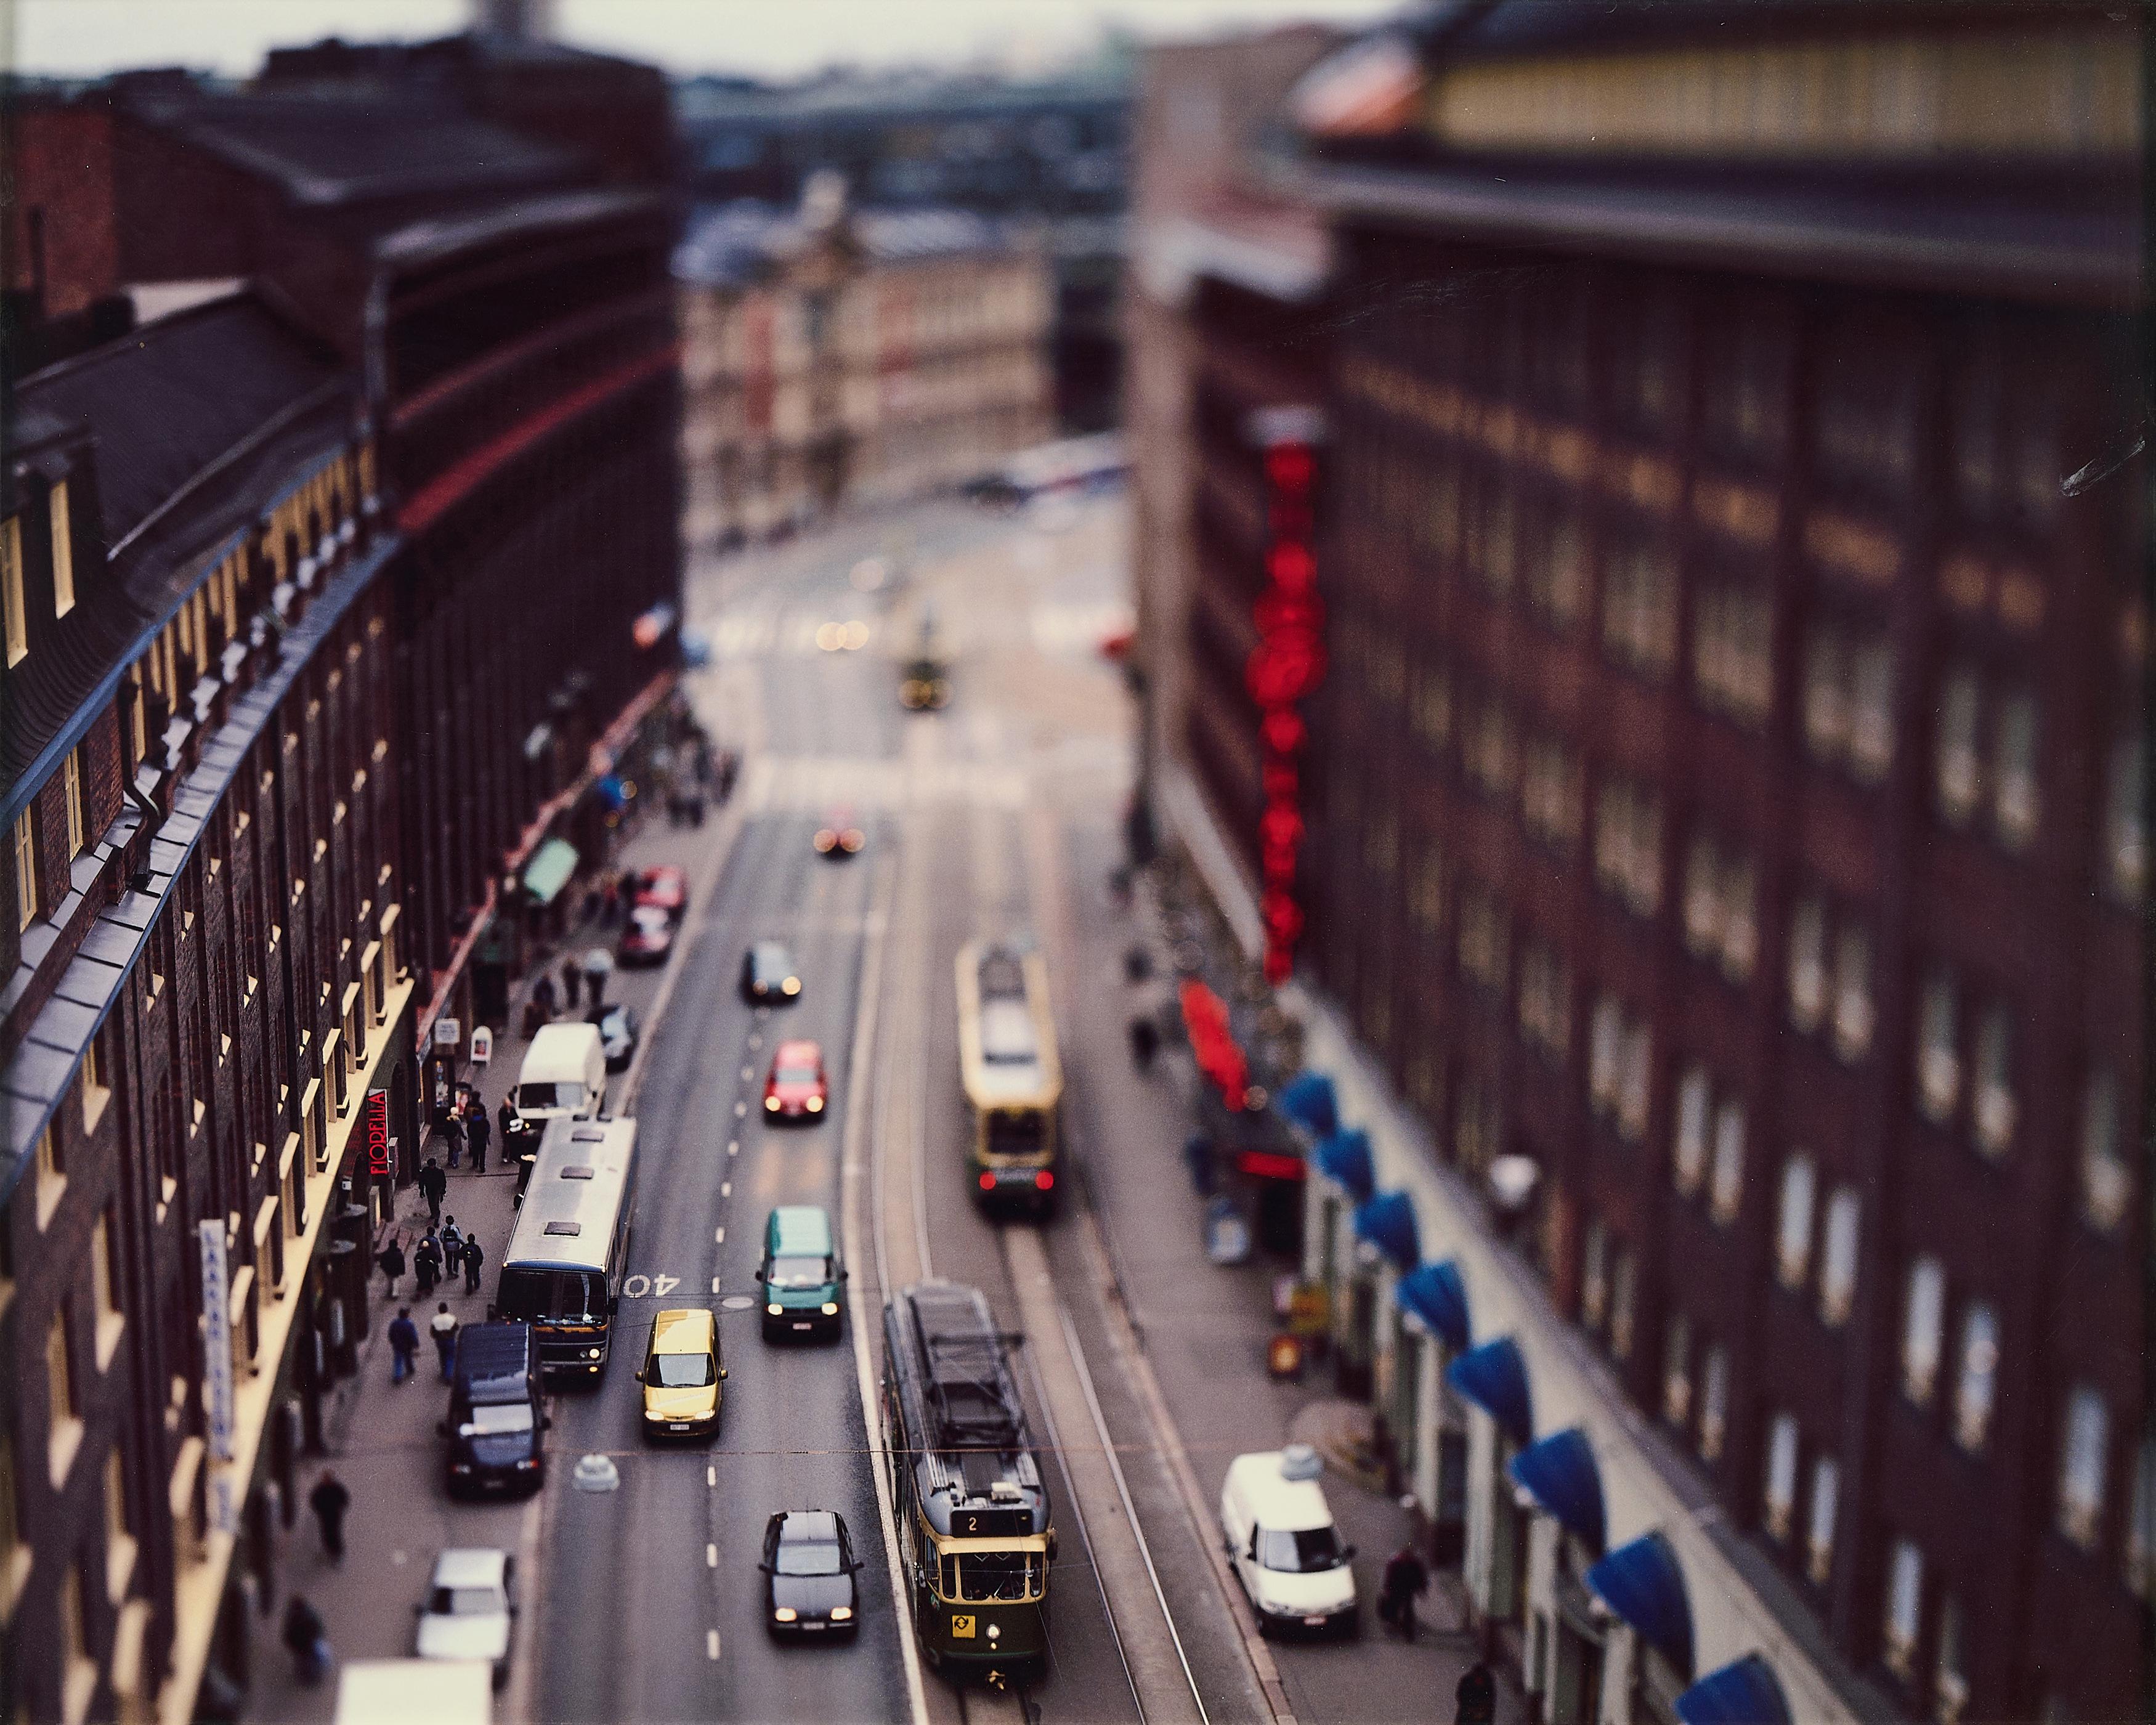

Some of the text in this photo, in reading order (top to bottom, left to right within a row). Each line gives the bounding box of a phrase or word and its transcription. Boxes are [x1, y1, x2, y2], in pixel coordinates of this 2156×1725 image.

[368, 1090, 389, 1175] FIORELLA
[623, 1273, 680, 1298] 40
[968, 1517, 976, 1531] 2
